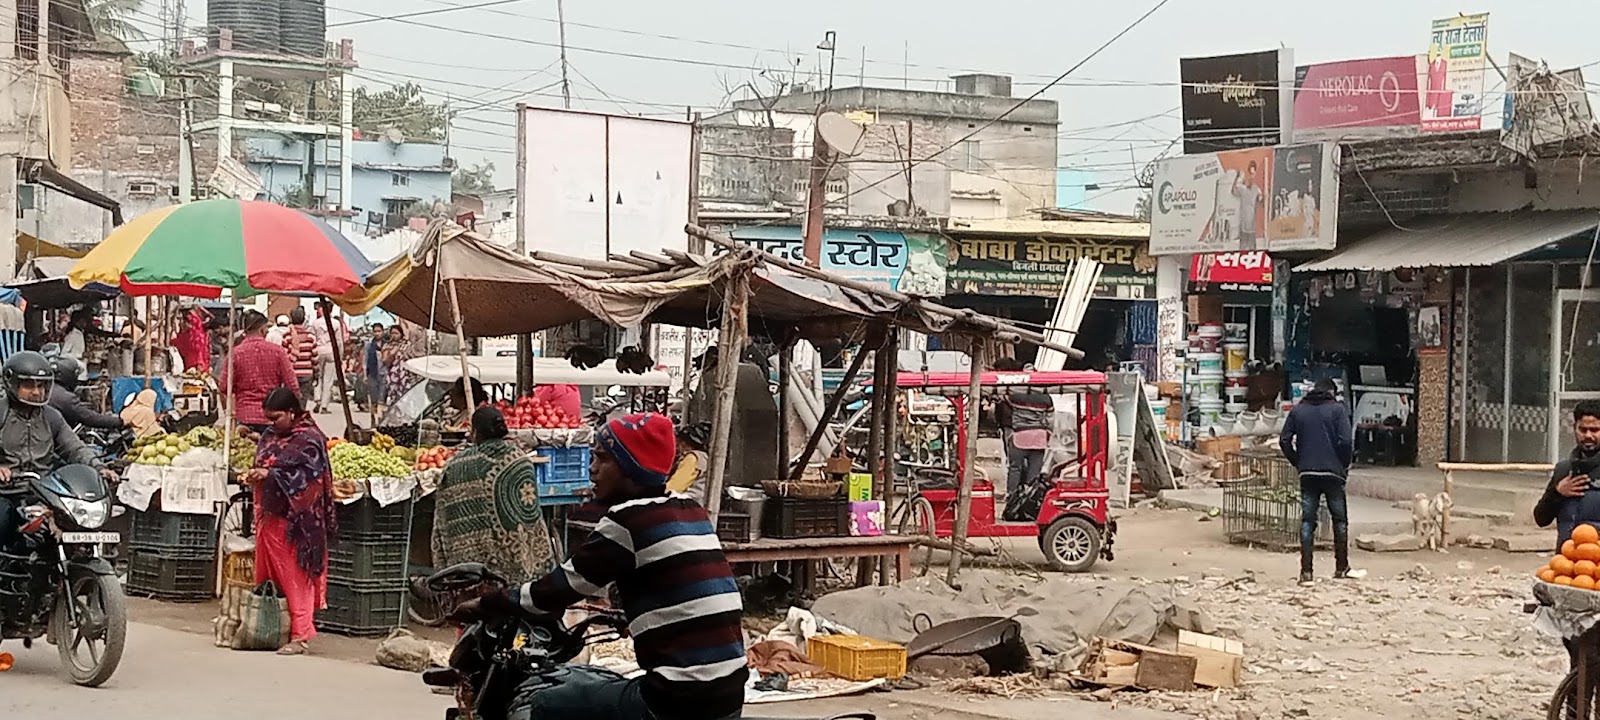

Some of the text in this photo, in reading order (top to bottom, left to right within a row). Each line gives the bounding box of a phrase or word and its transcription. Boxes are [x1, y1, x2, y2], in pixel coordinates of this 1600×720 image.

[1446, 28, 1462, 45] राज
[1463, 20, 1487, 43] टेलर्स
[1319, 74, 1374, 98] NEROLAC
[827, 234, 902, 267] स्टोर
[960, 239, 1017, 261] बाबा
